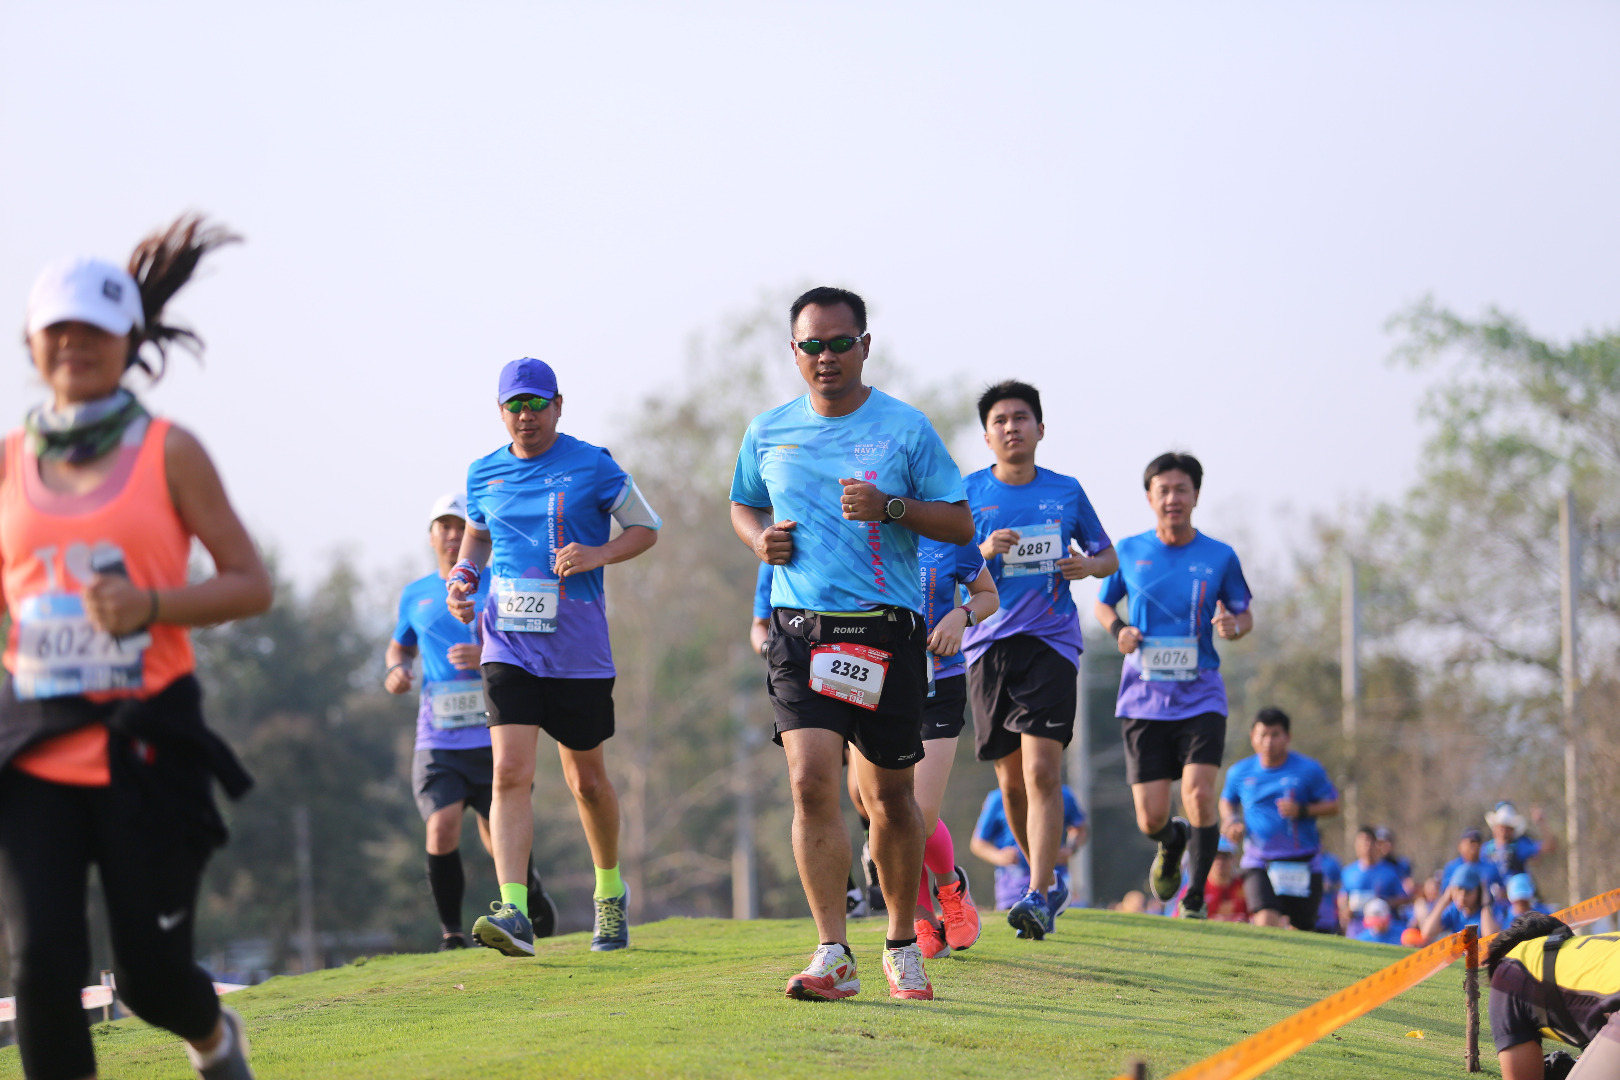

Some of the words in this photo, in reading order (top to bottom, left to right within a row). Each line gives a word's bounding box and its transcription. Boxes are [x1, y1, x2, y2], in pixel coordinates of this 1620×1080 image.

[547, 492, 555, 516] CROSS
[557, 491, 565, 523] SINGHA
[547, 517, 555, 554] COUNTRY
[557, 525, 565, 548] PARK
[1017, 541, 1051, 557] 6287
[929, 567, 937, 602] SINGHA
[506, 596, 545, 613] 6226
[832, 626, 866, 634] ROMIX
[933, 656, 941, 670] RAI
[1152, 650, 1189, 665] 6076
[830, 659, 870, 682] 2323
